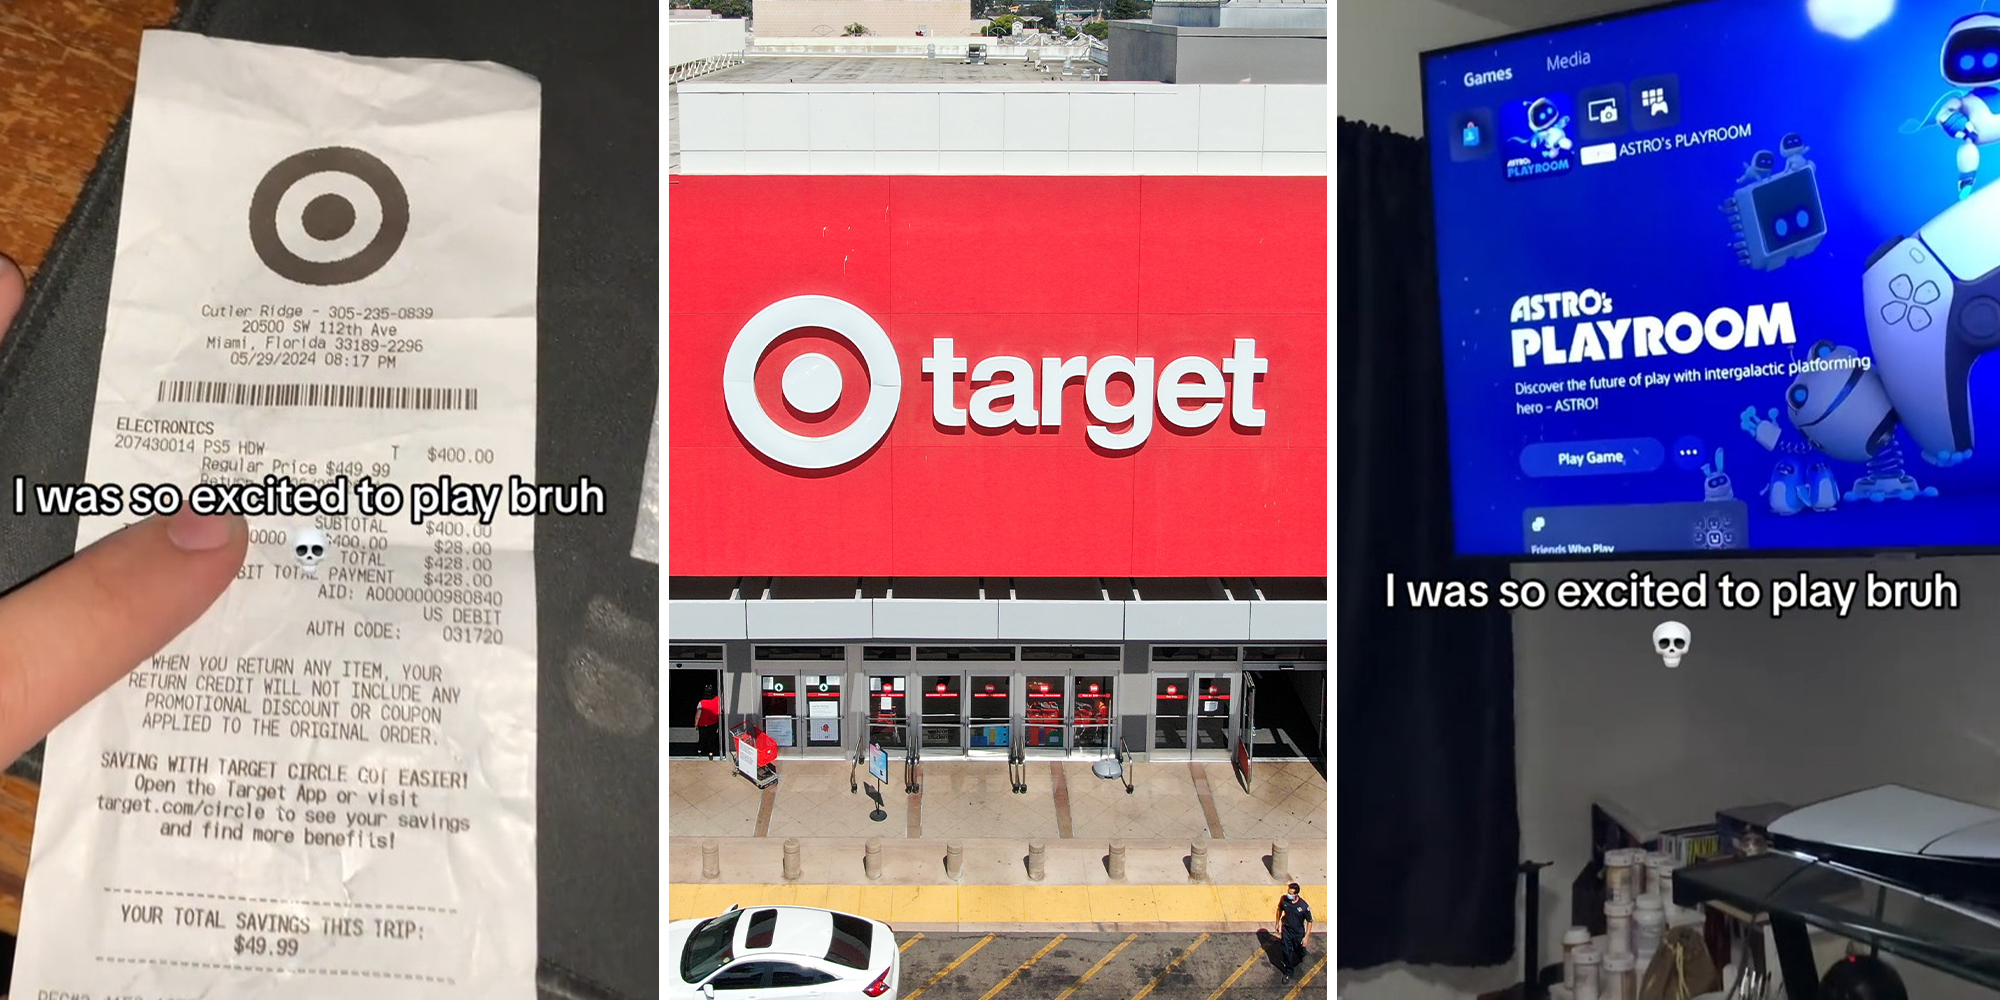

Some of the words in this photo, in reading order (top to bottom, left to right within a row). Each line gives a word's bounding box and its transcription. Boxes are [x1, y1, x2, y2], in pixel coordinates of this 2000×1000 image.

[1463, 65, 1513, 87] Games
[1547, 50, 1591, 72] Media
[1620, 137, 1672, 158] ASTRO's
[1676, 123, 1752, 149] PLAYROOM
[1507, 159, 1570, 178] PLAYROOM
[202, 304, 252, 318] Cutler
[260, 304, 303, 319] Ridge
[329, 306, 434, 320] 305-235-0839
[1510, 288, 1613, 323] ASTRO's
[242, 320, 284, 334] 20500
[293, 320, 311, 334] SW
[320, 321, 362, 336] 112th
[371, 324, 397, 337] Ave
[1511, 302, 1796, 368] PLAYROOM
[206, 336, 255, 351] Miami,
[266, 336, 326, 350] Florida
[335, 338, 423, 353] 33189-2296
[230, 352, 316, 367] 05/29/2024
[325, 353, 369, 368] 08:17
[378, 355, 396, 369] PM
[1515, 380, 1563, 396] Discover
[1567, 377, 1587, 392] the
[1589, 374, 1626, 391] future
[1629, 372, 1643, 387] of
[1644, 370, 1671, 389] play
[1674, 369, 1701, 384] with
[1704, 361, 1785, 382] intergalactic
[1789, 354, 1871, 377] platforming
[922, 337, 1268, 451] target
[1516, 401, 1543, 415] hero
[1554, 397, 1599, 413] ASTRO!
[116, 416, 214, 435] ELECTRONICS
[114, 434, 195, 453] 207430014
[204, 439, 230, 454] PS5
[239, 441, 265, 456] HDW
[392, 445, 399, 461] T
[427, 446, 494, 463] $400.00
[1558, 453, 1584, 468] Play
[1586, 451, 1624, 464] Game
[202, 457, 263, 473] Regular
[272, 459, 317, 475] Price
[326, 461, 390, 478] $44999
[315, 516, 388, 533] SUBTOTAL
[425, 521, 492, 539] $400.00
[434, 540, 492, 556] $28.00
[1567, 543, 1592, 554] Who
[341, 551, 386, 567] TOTAL
[424, 556, 492, 572] $428.00
[237, 565, 265, 580] BIT
[329, 567, 394, 584] PAYMENT
[423, 571, 492, 588] $428.00
[318, 584, 353, 599] AID:
[366, 586, 502, 606] A0000000980840
[423, 607, 443, 622] US
[452, 608, 502, 625] DEBIT
[306, 621, 345, 638] AUTH
[354, 622, 401, 639] CODE:
[443, 626, 503, 644] 031720
[150, 655, 190, 672] WHEN
[199, 656, 228, 672] YOU
[236, 658, 294, 675] RETURN
[303, 660, 331, 676] ANY
[342, 661, 388, 680] ITEM,
[402, 664, 442, 682] YOUR
[128, 672, 186, 690] RETURN
[196, 676, 253, 694] CREDIT
[264, 678, 300, 696] WILL
[312, 681, 340, 698] NOT
[352, 681, 421, 702] INCLUDE
[432, 686, 461, 704] ANY
[145, 693, 252, 715] PROMOTIONAL
[262, 699, 340, 719] DISCOUNT
[350, 703, 371, 720] OR
[380, 705, 442, 724] COUPON
[142, 713, 212, 733] APPLIED
[223, 717, 241, 734] TO
[252, 719, 280, 737] THE
[290, 721, 369, 742] ORIGINAL
[380, 726, 438, 746] ORDER.
[101, 752, 158, 772] SAVING
[168, 756, 208, 774] WITH
[219, 758, 277, 779] TARGET
[288, 763, 348, 783] CIRCLE
[358, 766, 388, 784] GOT
[399, 769, 468, 790] EASIER!
[135, 774, 176, 796] Open
[187, 777, 215, 797] the
[228, 781, 286, 803] Target
[297, 784, 327, 805] App
[337, 789, 357, 804] or
[368, 788, 418, 808] visit
[97, 794, 265, 821] target.com/circle
[277, 804, 296, 823] to
[305, 809, 336, 824] see
[345, 811, 387, 832] your
[398, 812, 470, 834] savings
[160, 820, 191, 838] and
[202, 821, 243, 842] find
[253, 827, 295, 844] more
[305, 828, 395, 850] benefits!
[120, 904, 164, 925] YOUR
[175, 908, 226, 930] TOTAL
[236, 911, 311, 935] SAVINGS
[322, 915, 364, 938] THIS
[376, 918, 425, 940] TRIP:
[233, 934, 299, 958] $49.99
